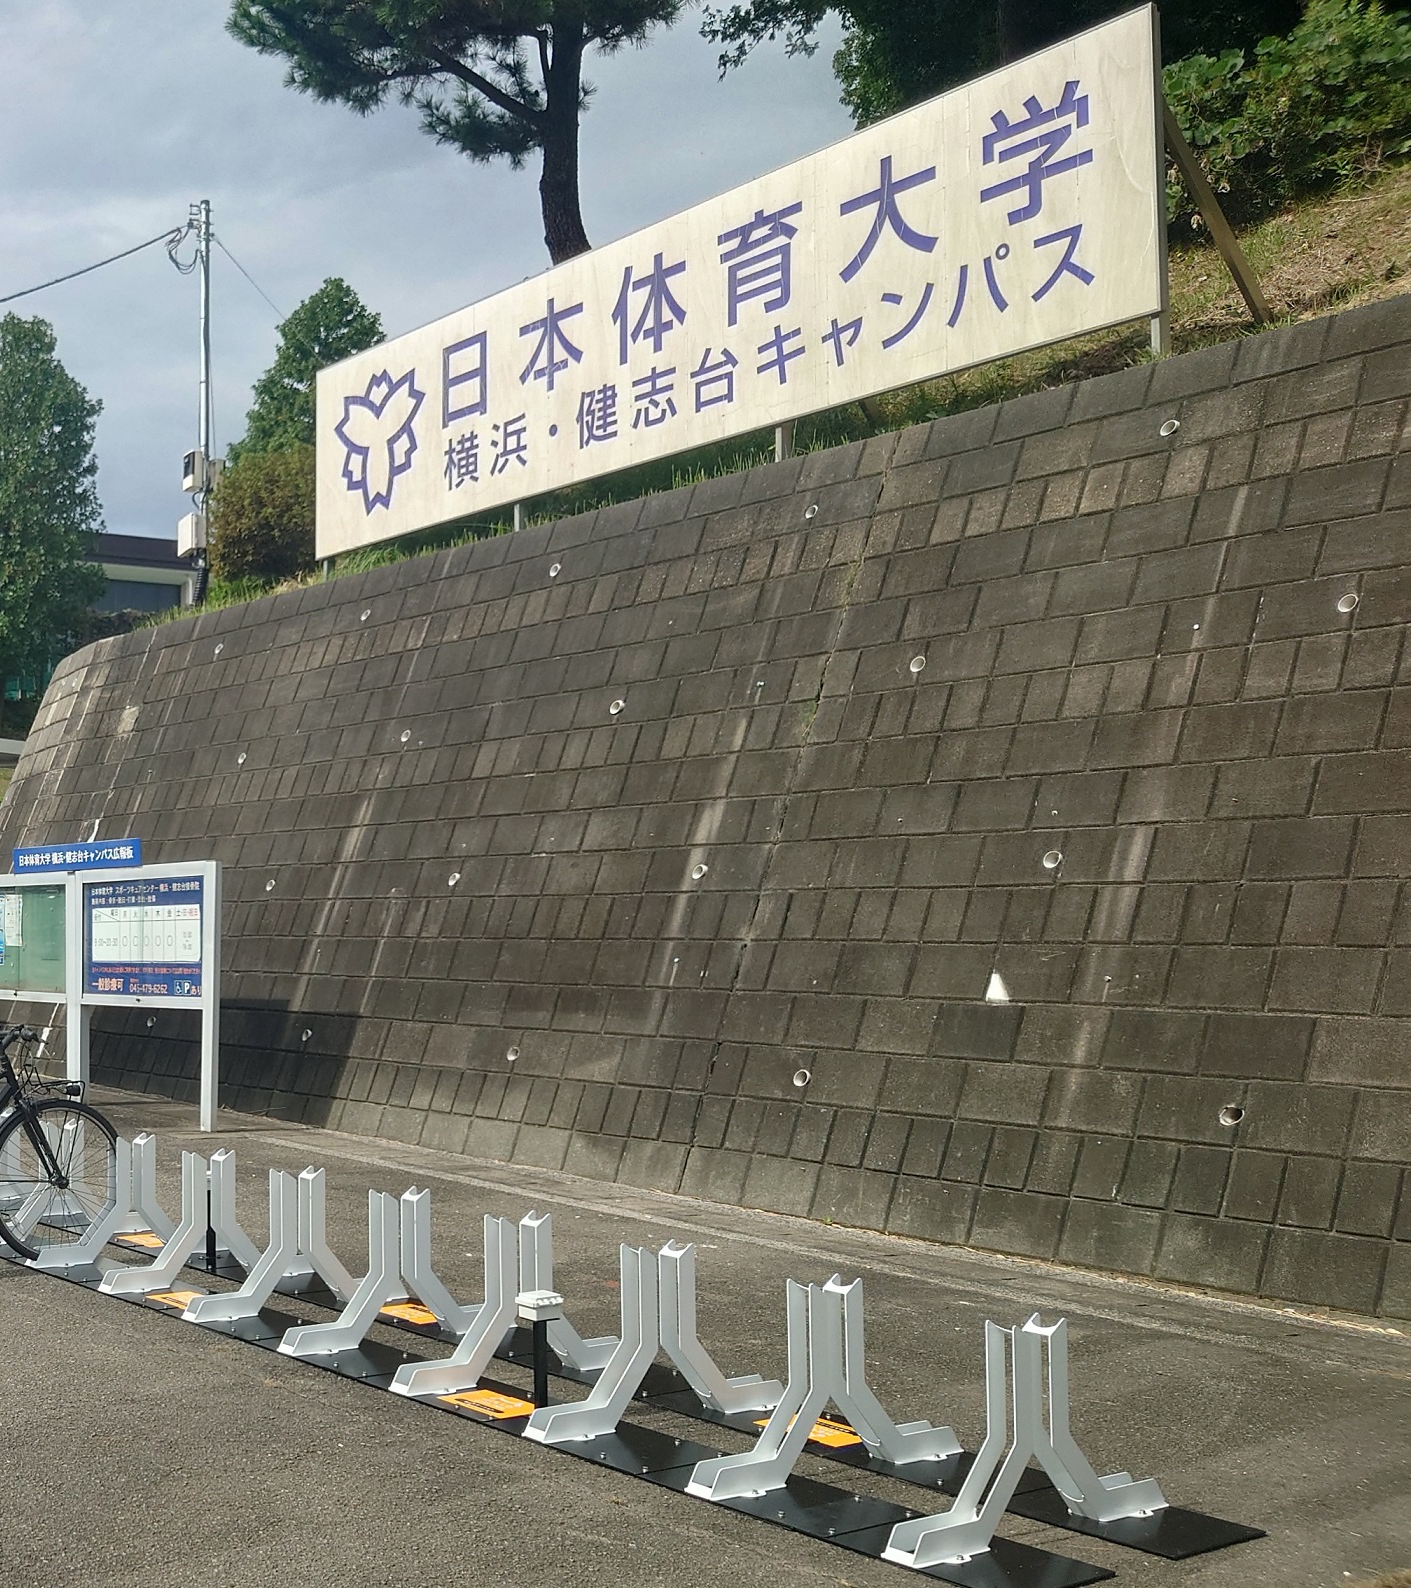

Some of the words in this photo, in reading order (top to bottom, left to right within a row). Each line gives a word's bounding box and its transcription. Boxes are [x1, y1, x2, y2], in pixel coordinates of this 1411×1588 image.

[441, 80, 1094, 428] 日本体育大学
[443, 223, 1095, 492] 横浜・健志台キャンパス
[19, 853, 51, 867] 日本体育大学
